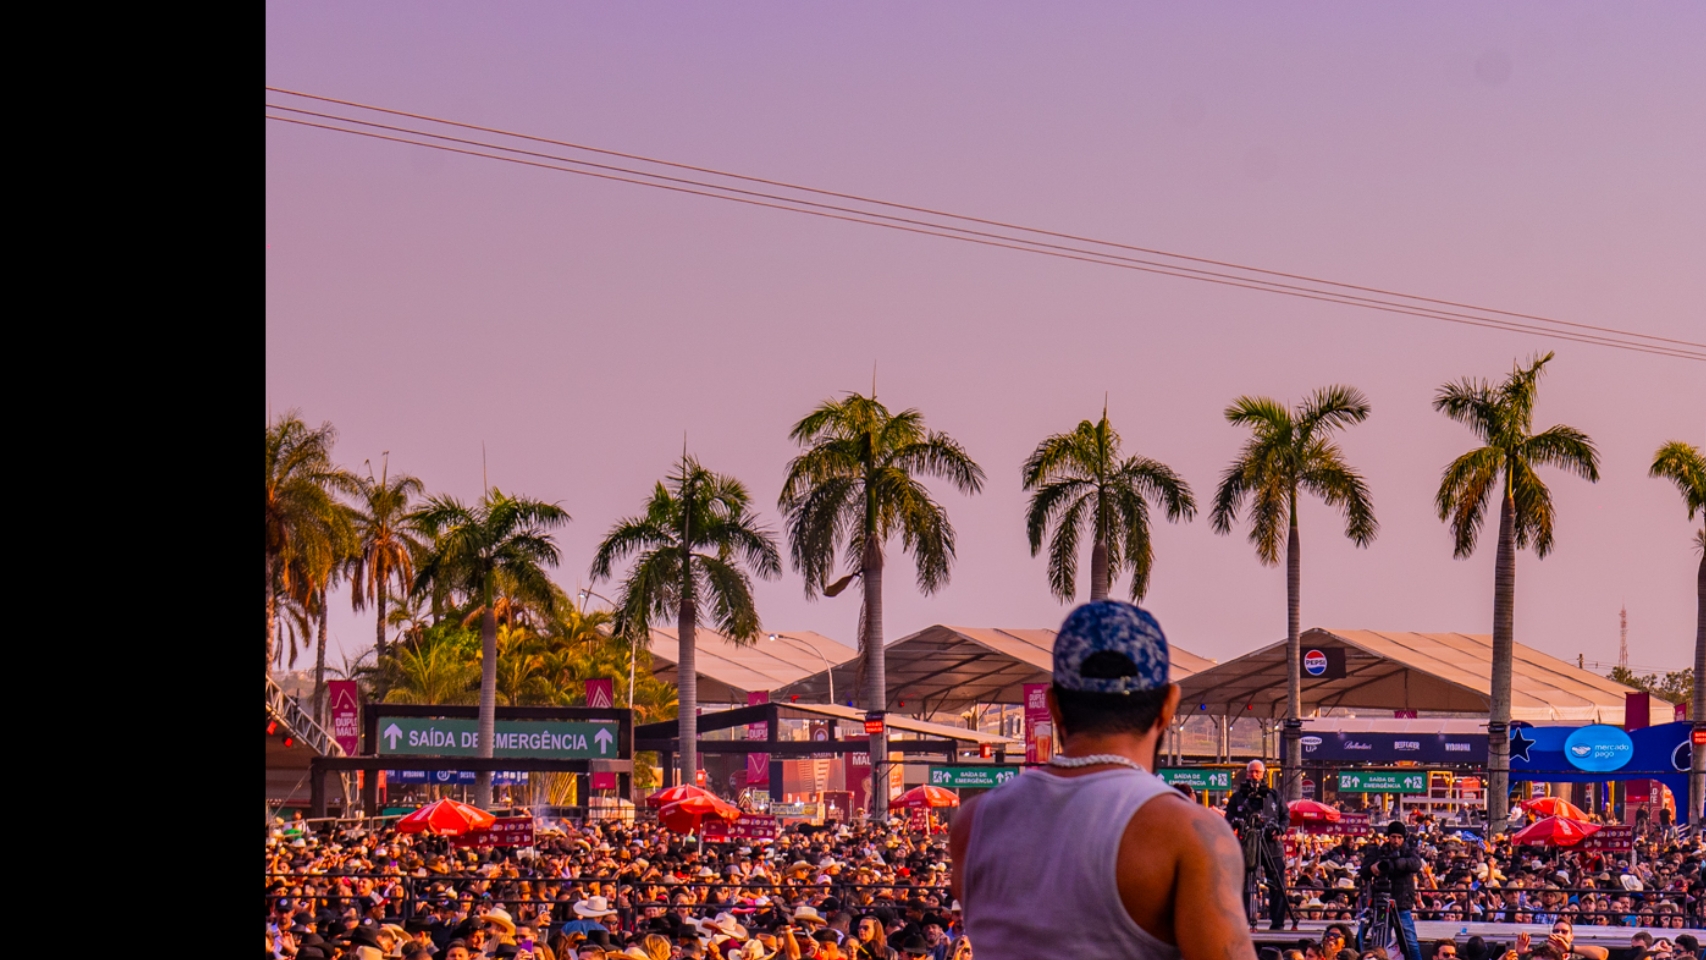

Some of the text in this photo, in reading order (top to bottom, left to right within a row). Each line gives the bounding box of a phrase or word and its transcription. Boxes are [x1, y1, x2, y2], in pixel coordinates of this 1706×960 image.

[409, 727, 588, 750] SAÍDA DE MERGÊNCIA
[1594, 743, 1629, 751] mercado
[1594, 751, 1615, 759] pago
[852, 755, 872, 766] MAL
